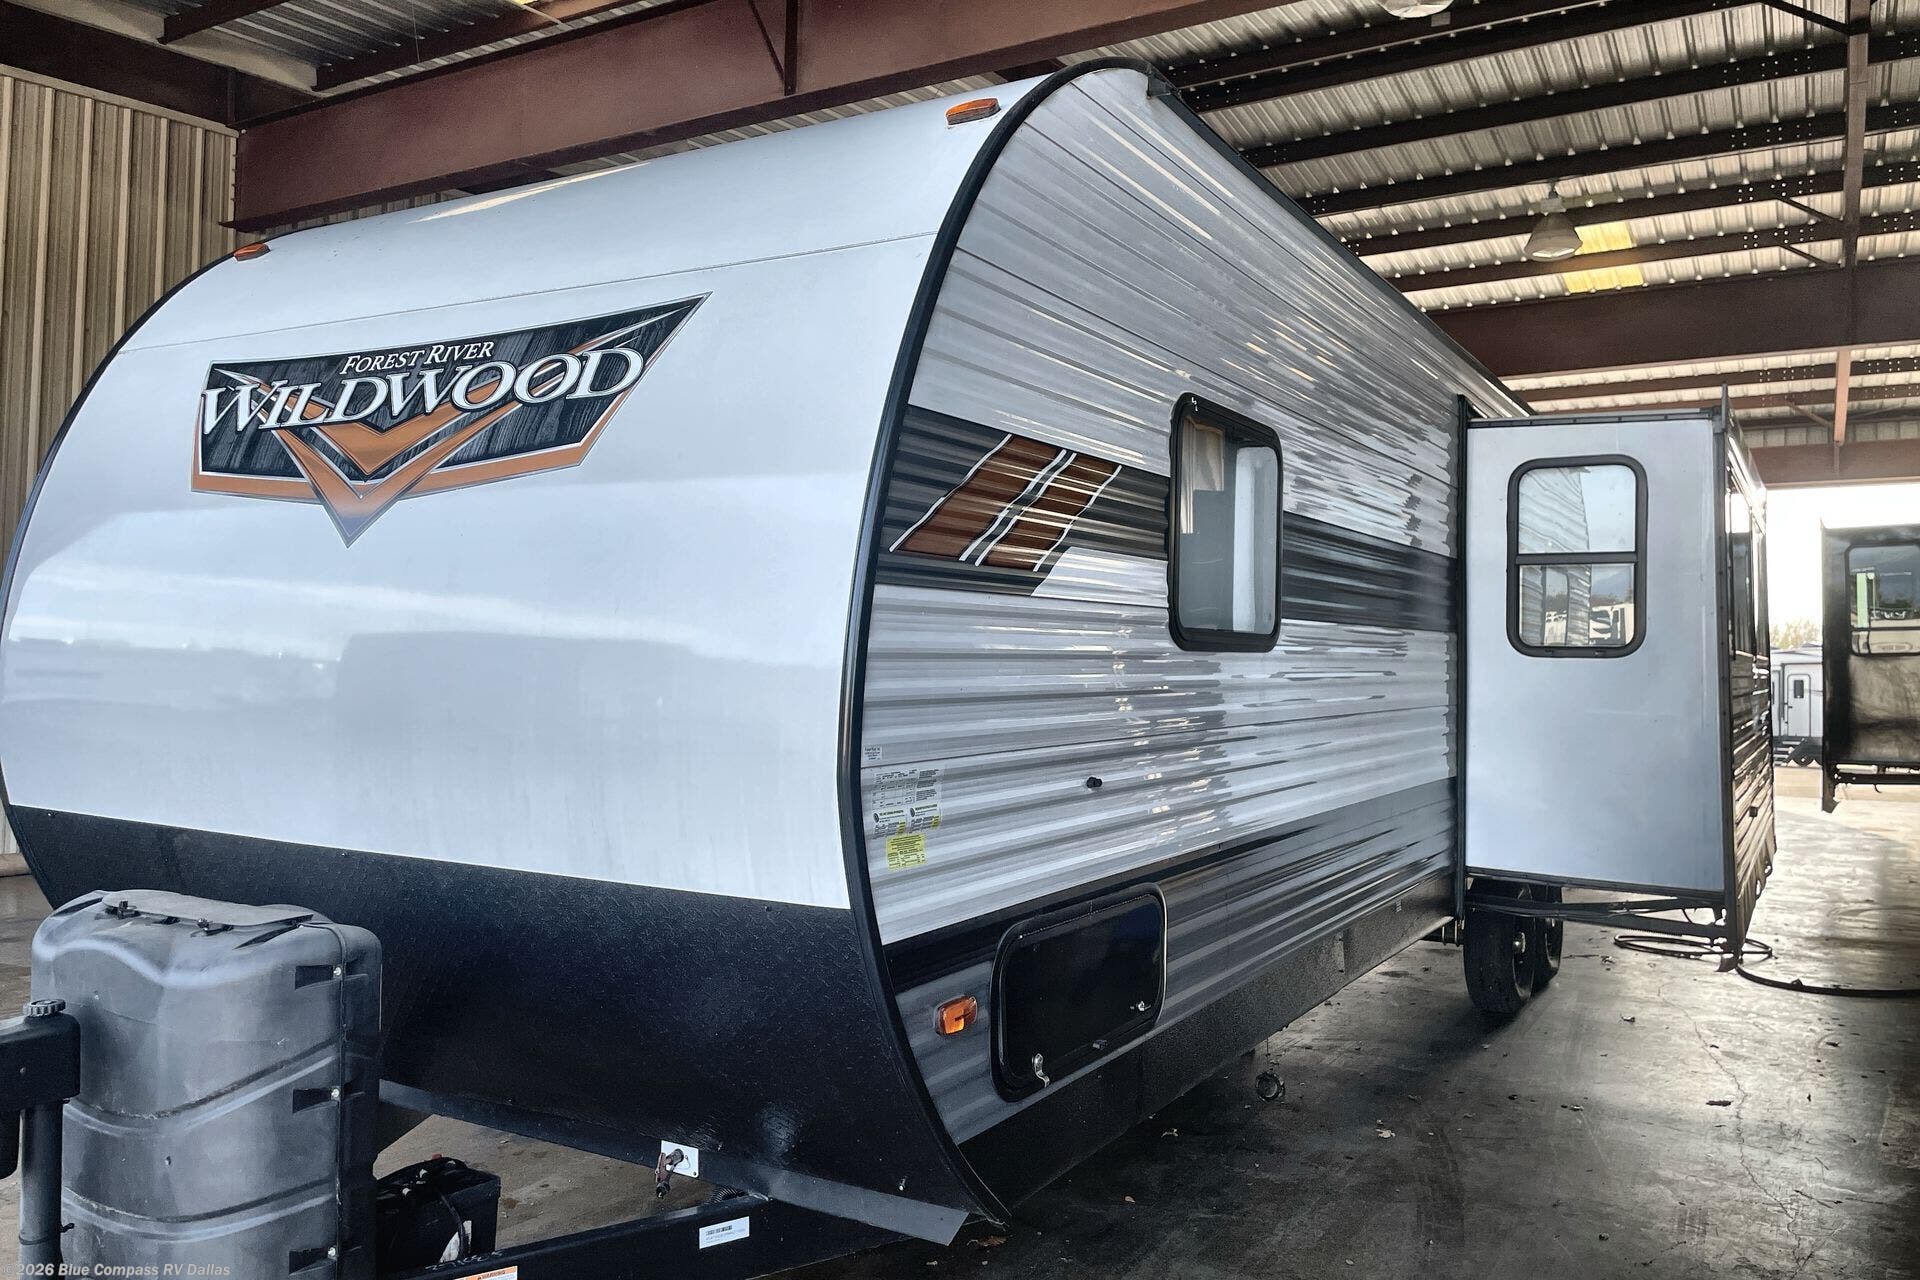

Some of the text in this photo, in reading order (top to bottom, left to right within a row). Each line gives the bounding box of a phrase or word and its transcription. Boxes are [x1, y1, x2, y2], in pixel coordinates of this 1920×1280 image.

[340, 341, 494, 375] FOREST RIVER
[201, 347, 645, 435] WILDWOOD
